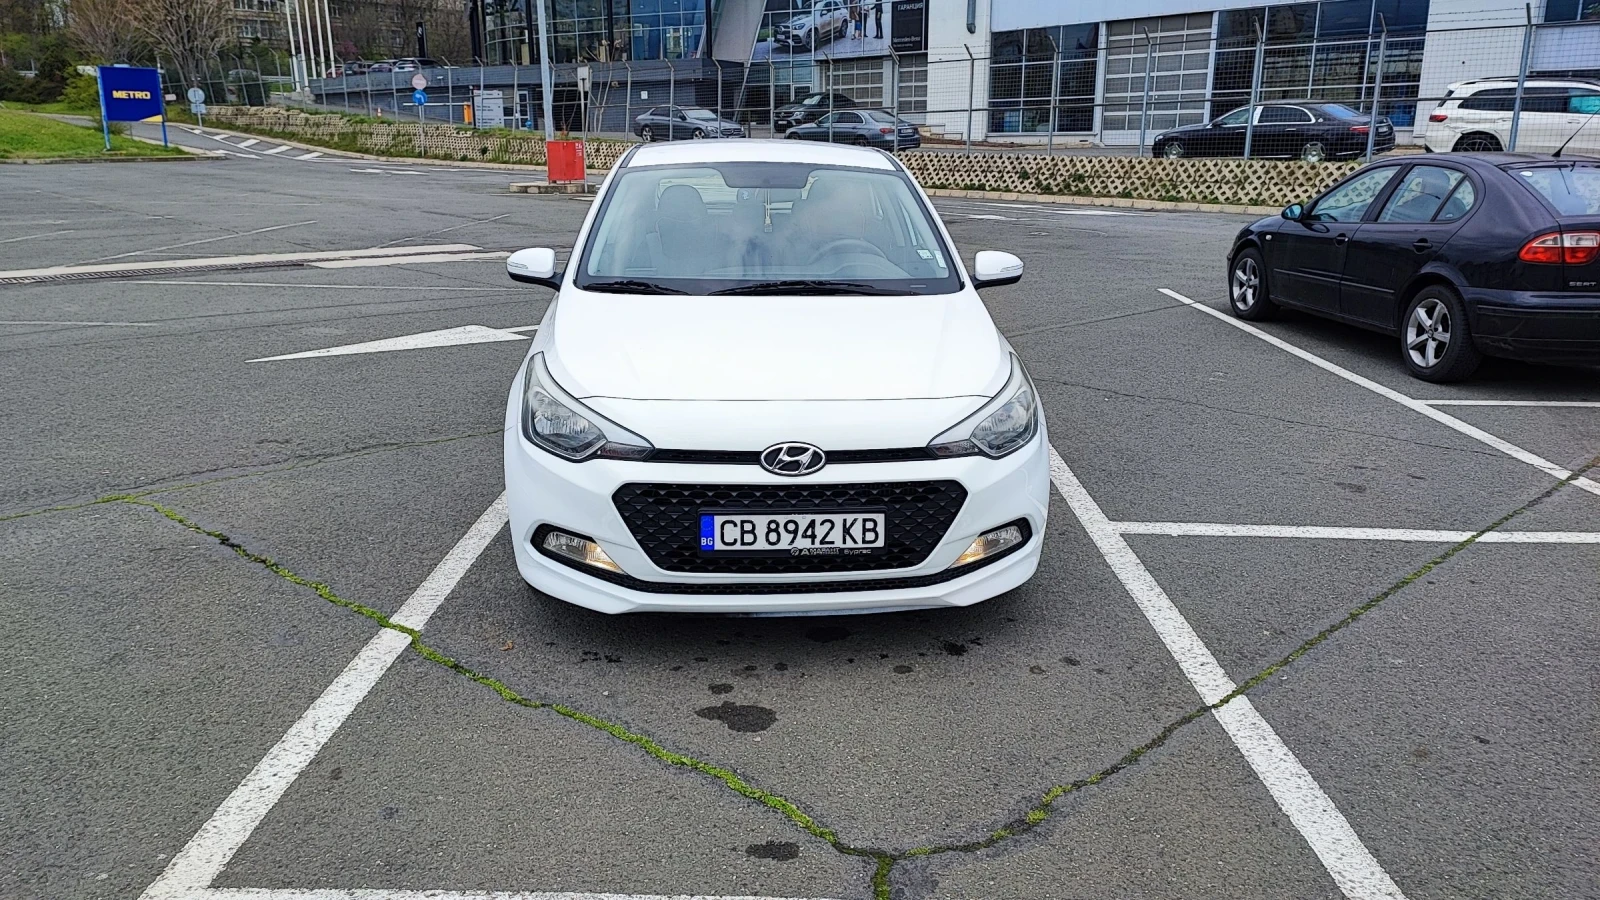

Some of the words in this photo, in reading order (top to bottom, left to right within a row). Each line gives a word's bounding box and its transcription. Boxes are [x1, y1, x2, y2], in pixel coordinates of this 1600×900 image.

[112, 90, 151, 99] METRO
[720, 519, 758, 547] CB
[765, 519, 836, 546] 8942
[842, 518, 880, 545] KB
[701, 537, 713, 546] BG
